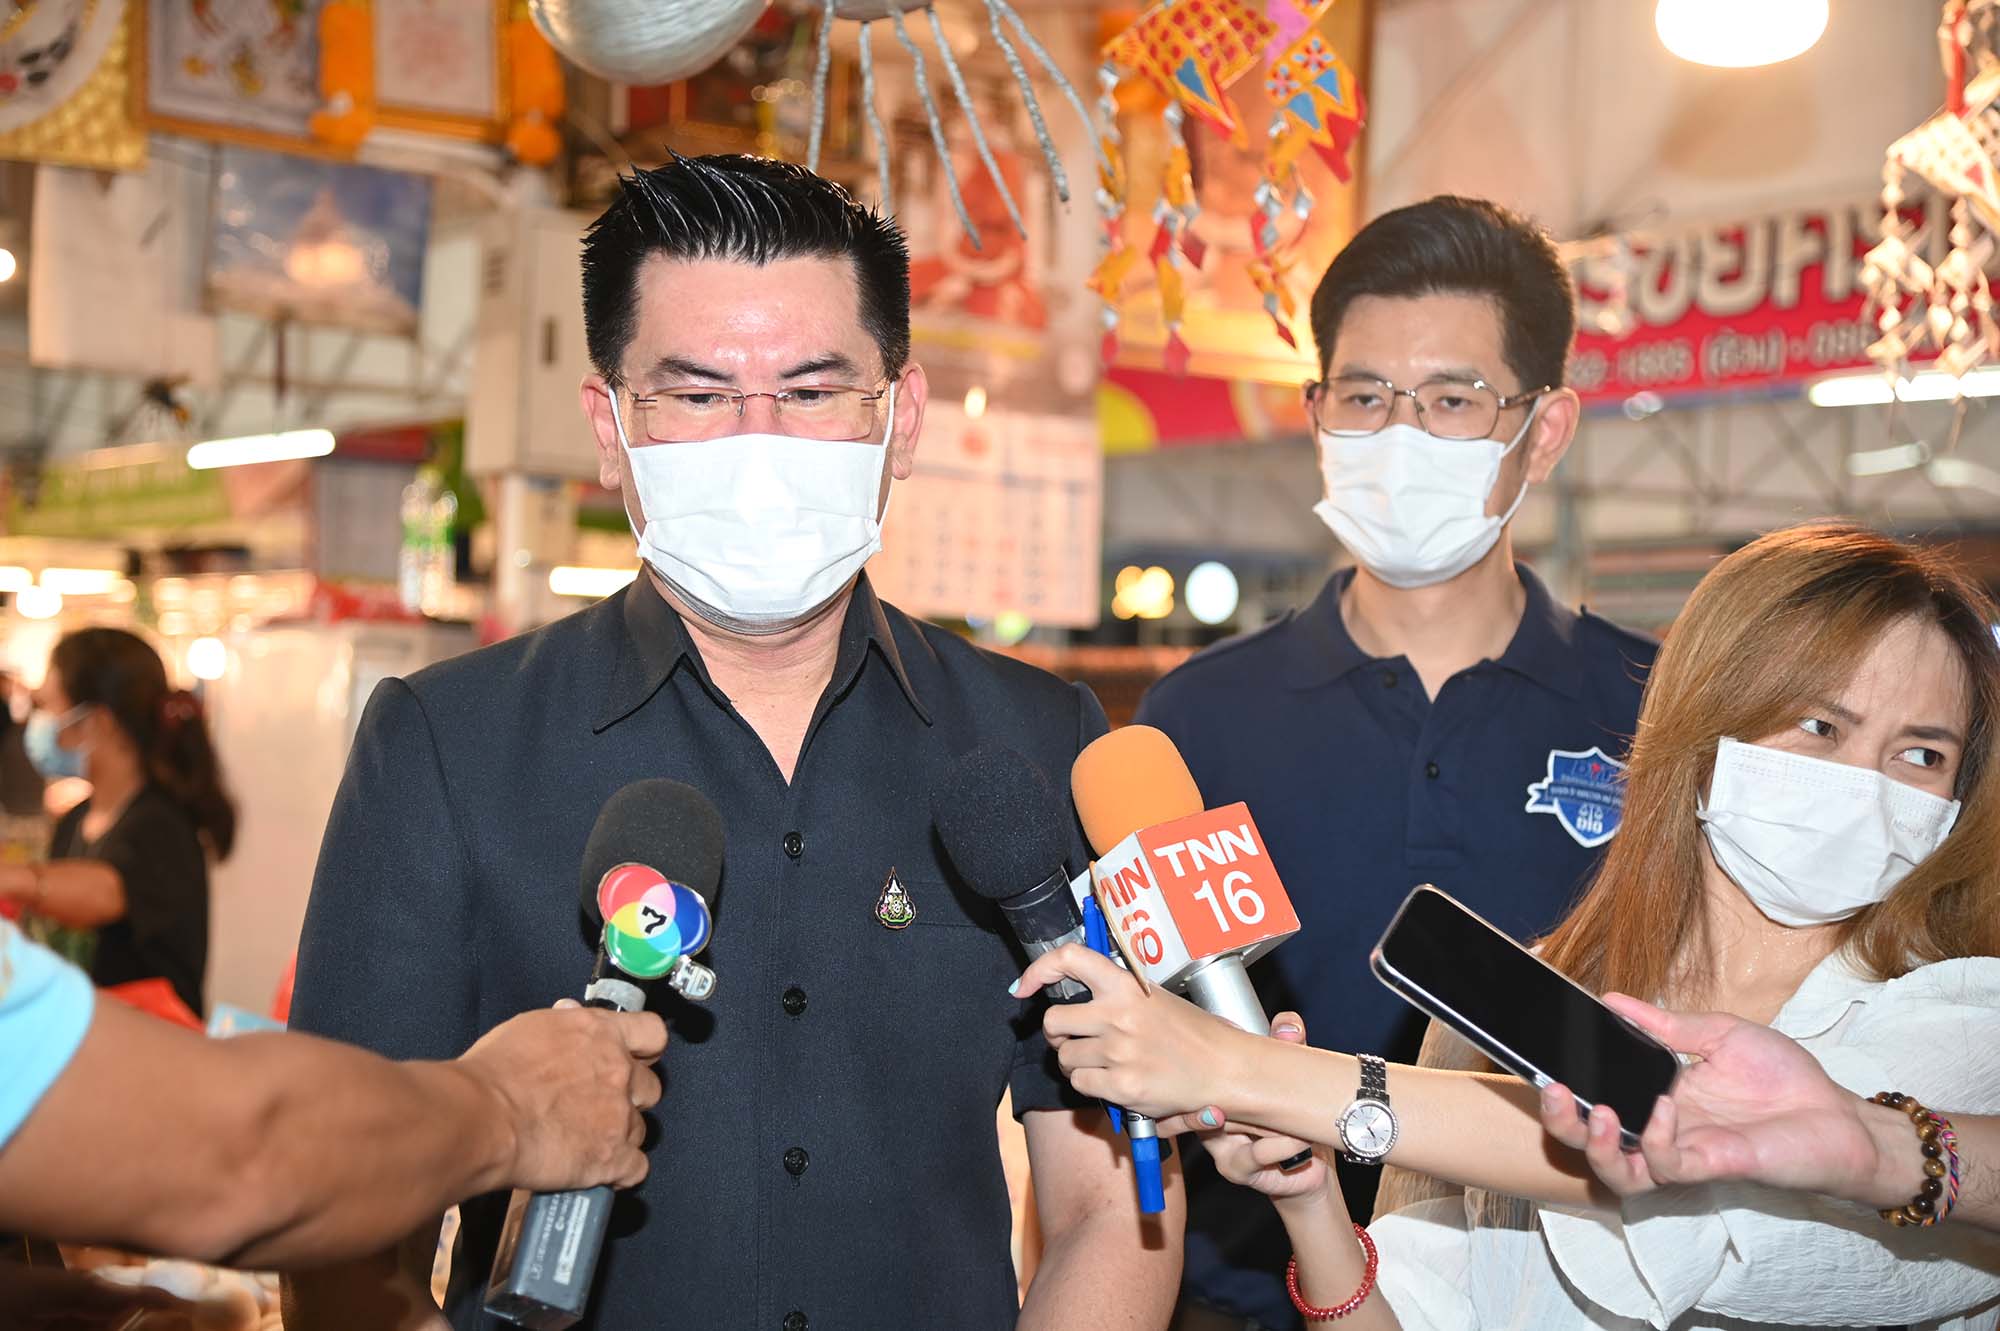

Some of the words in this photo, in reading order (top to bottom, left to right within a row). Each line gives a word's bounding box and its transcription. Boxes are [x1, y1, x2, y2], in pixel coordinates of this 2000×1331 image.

[1153, 823, 1260, 878] TNN
[641, 905, 668, 935] 7
[1192, 870, 1266, 933] 16
